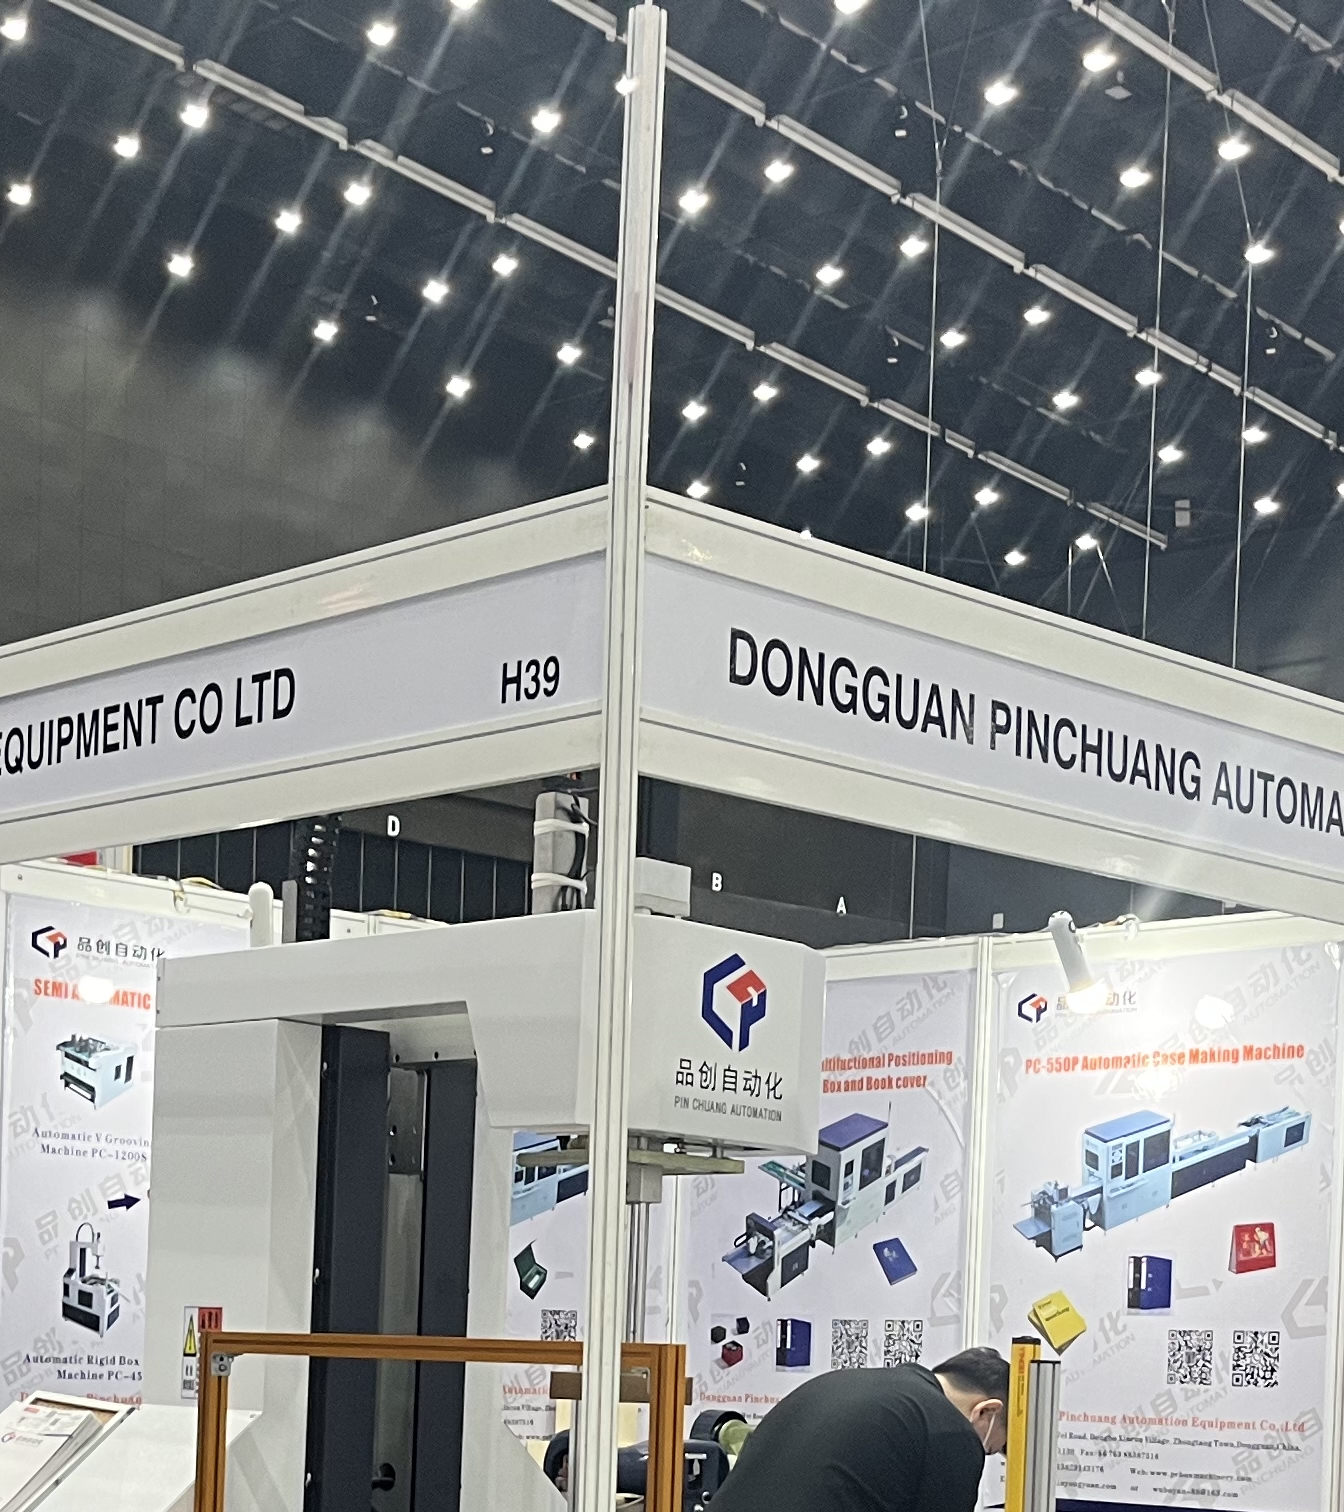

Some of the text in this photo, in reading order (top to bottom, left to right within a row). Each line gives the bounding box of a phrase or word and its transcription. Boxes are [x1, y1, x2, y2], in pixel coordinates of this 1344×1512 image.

[500, 655, 560, 704] H39
[174, 682, 223, 740] CO
[235, 667, 296, 728] LTD
[730, 627, 975, 745] DONGGUAN
[990, 699, 1200, 801] PINCHUANG
[387, 815, 400, 837] D
[34, 978, 68, 999] SEMI
[887, 1050, 953, 1068] Positioning
[1025, 1055, 1079, 1074] PC-550P
[1081, 1052, 1150, 1071] Automatic
[1189, 1045, 1239, 1065] Making
[1242, 1042, 1305, 1061] Machine
[675, 1058, 783, 1100] 品创自动化
[822, 1074, 928, 1093] Box and Book cover
[674, 1095, 782, 1122] PIN CHUANG AUTOMATION
[32, 1127, 92, 1142] Automatic
[40, 1143, 88, 1157] Machine
[23, 1353, 140, 1367] Automatic Rigid Box
[57, 1369, 104, 1380] Machine
[1058, 1410, 1117, 1425] Pinchuang
[1121, 1414, 1188, 1427] Automation
[1192, 1417, 1257, 1430] Equipment
